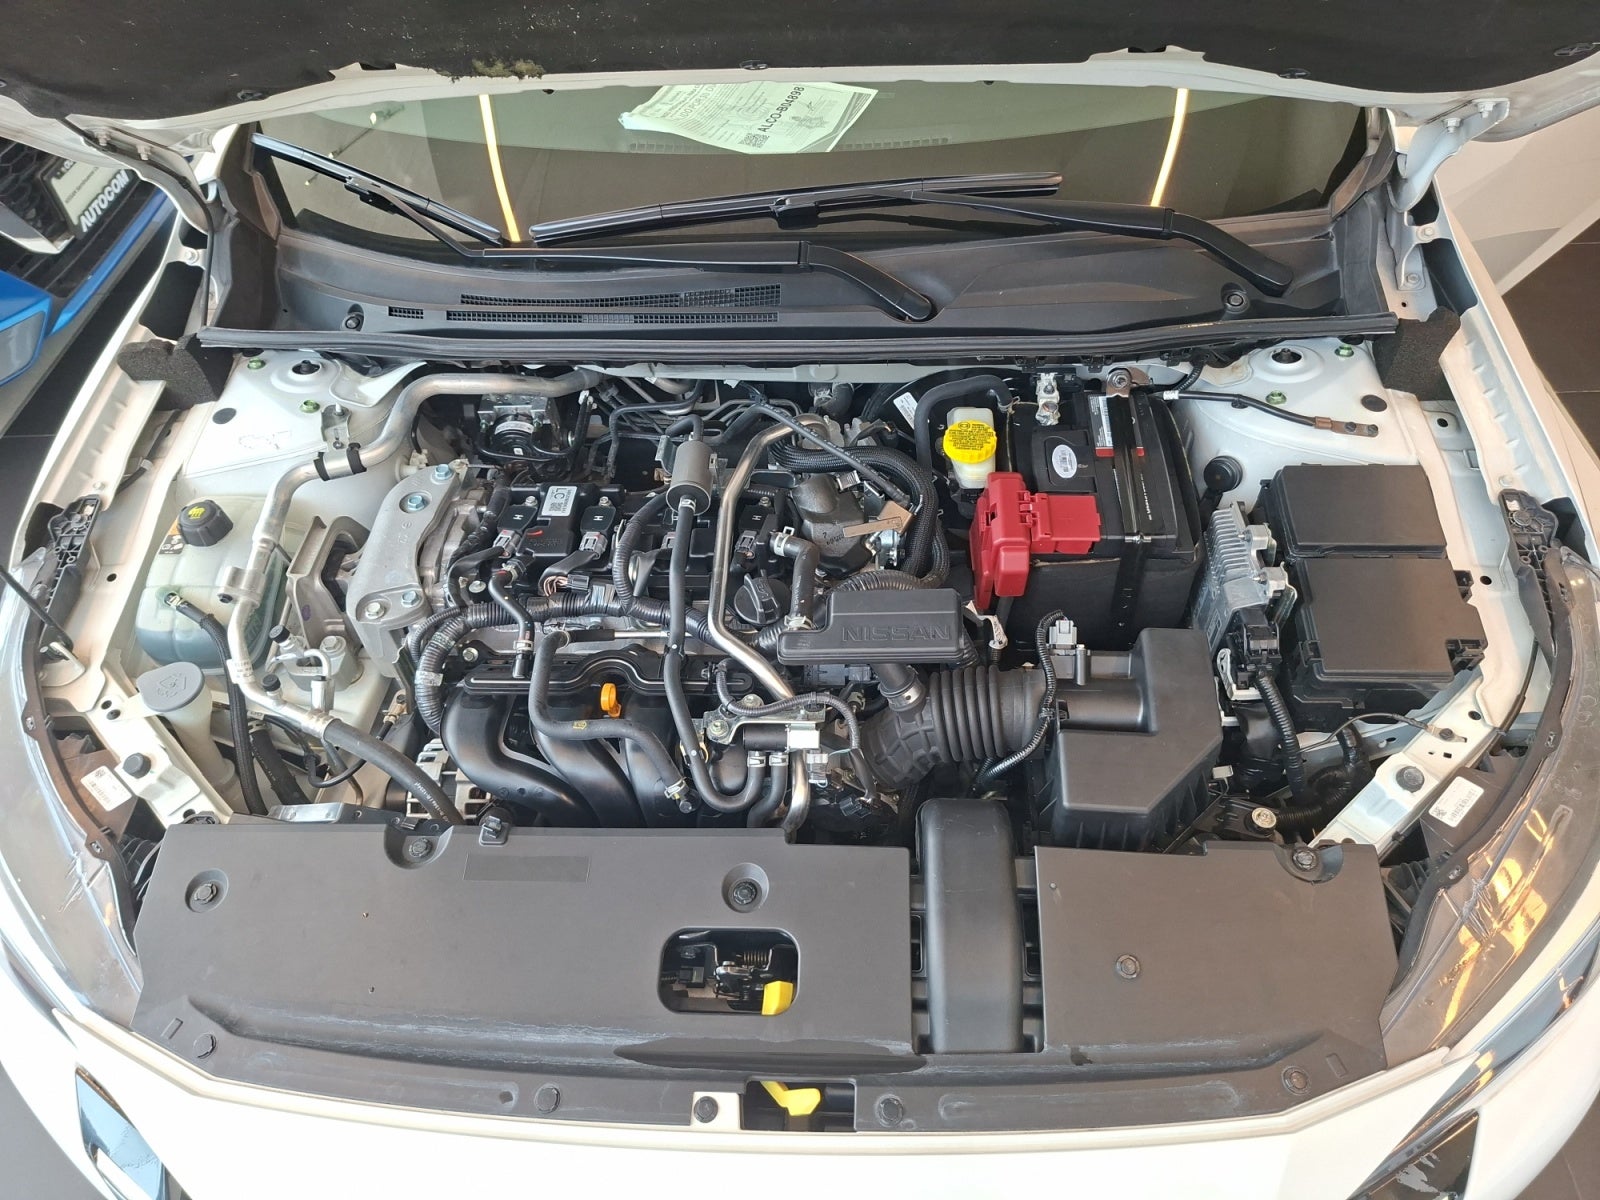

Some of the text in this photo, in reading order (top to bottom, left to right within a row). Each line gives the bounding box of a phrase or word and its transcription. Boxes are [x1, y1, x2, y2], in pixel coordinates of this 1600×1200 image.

[758, 85, 805, 133] ALCO-B04898
[80, 170, 129, 232] AUTOCOM
[842, 624, 951, 643] NISSAN
